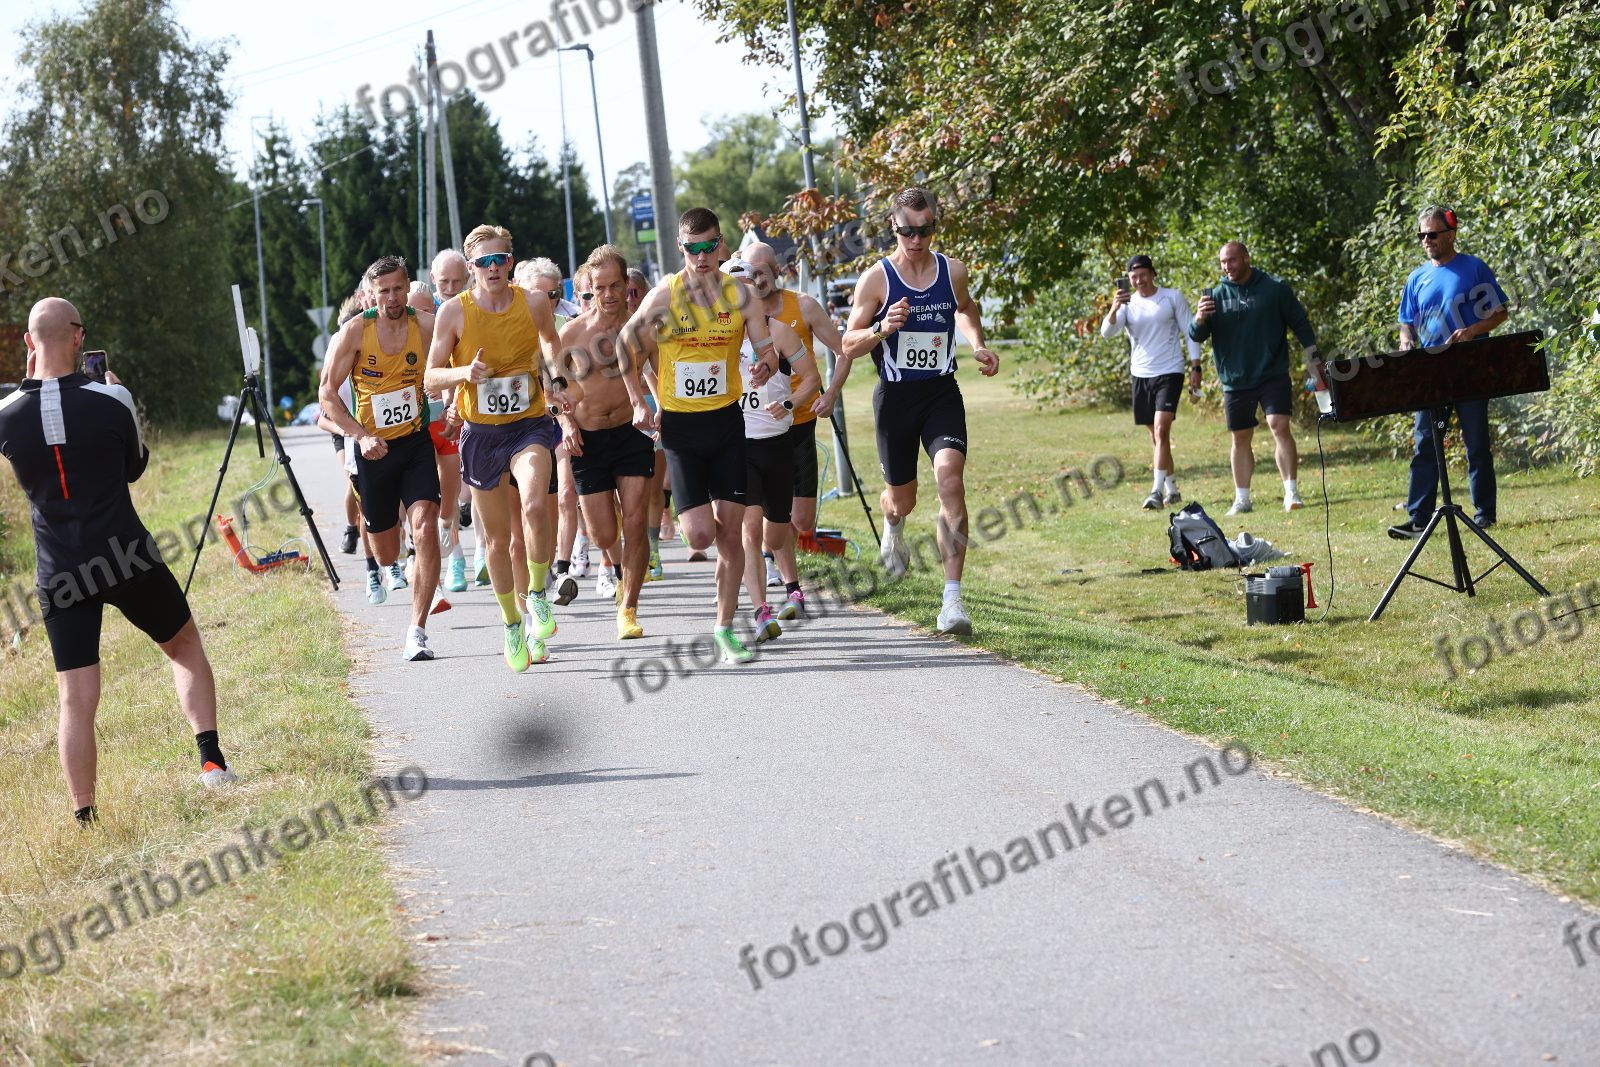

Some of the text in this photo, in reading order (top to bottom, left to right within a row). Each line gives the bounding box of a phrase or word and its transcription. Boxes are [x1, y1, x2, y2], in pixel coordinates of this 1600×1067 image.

[909, 303, 952, 313] REBANKEN
[916, 313, 933, 322] SØR
[906, 348, 938, 369] 993
[684, 377, 718, 397] 942
[487, 393, 521, 413] 992
[382, 403, 412, 426] 252
